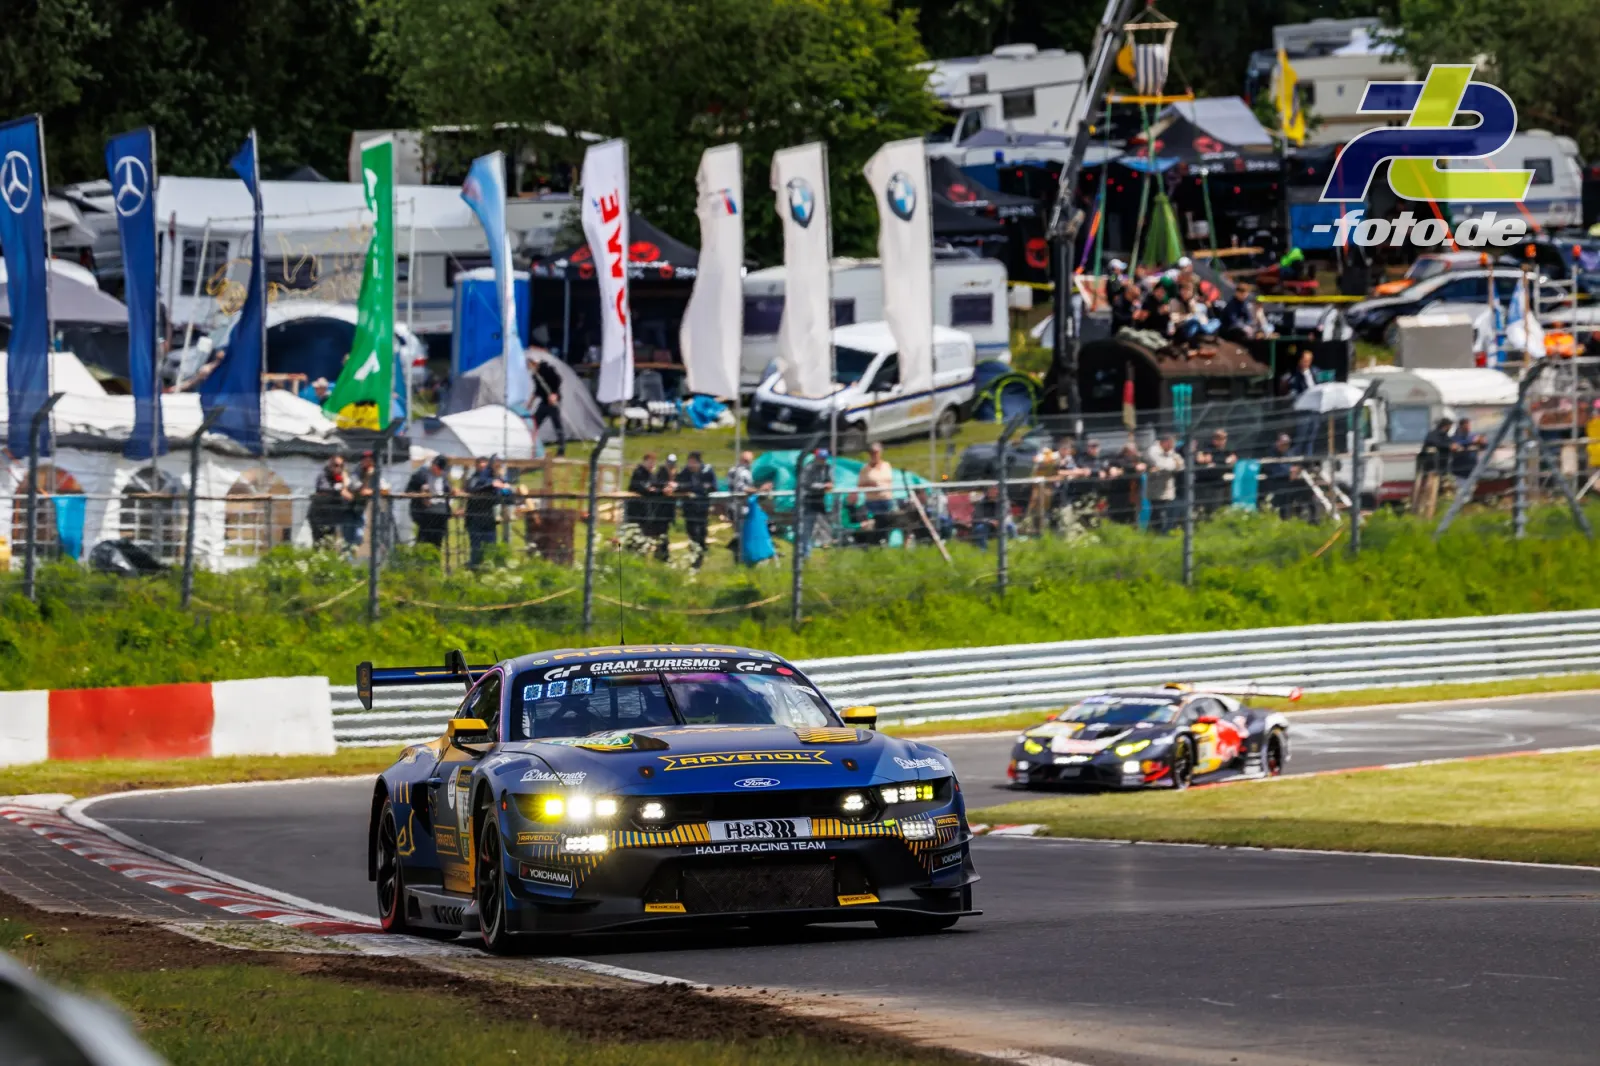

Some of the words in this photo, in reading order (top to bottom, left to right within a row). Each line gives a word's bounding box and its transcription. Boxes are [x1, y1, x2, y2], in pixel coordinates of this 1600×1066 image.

[589, 660, 639, 672] GRAN
[679, 752, 811, 766] RAVENOL
[743, 778, 772, 787] Ford
[520, 834, 555, 842] RAVENOL
[695, 844, 738, 855] HAUPT
[741, 842, 789, 853] RACING
[791, 841, 826, 850] TEAM
[530, 868, 570, 883] YOKOHAMA
